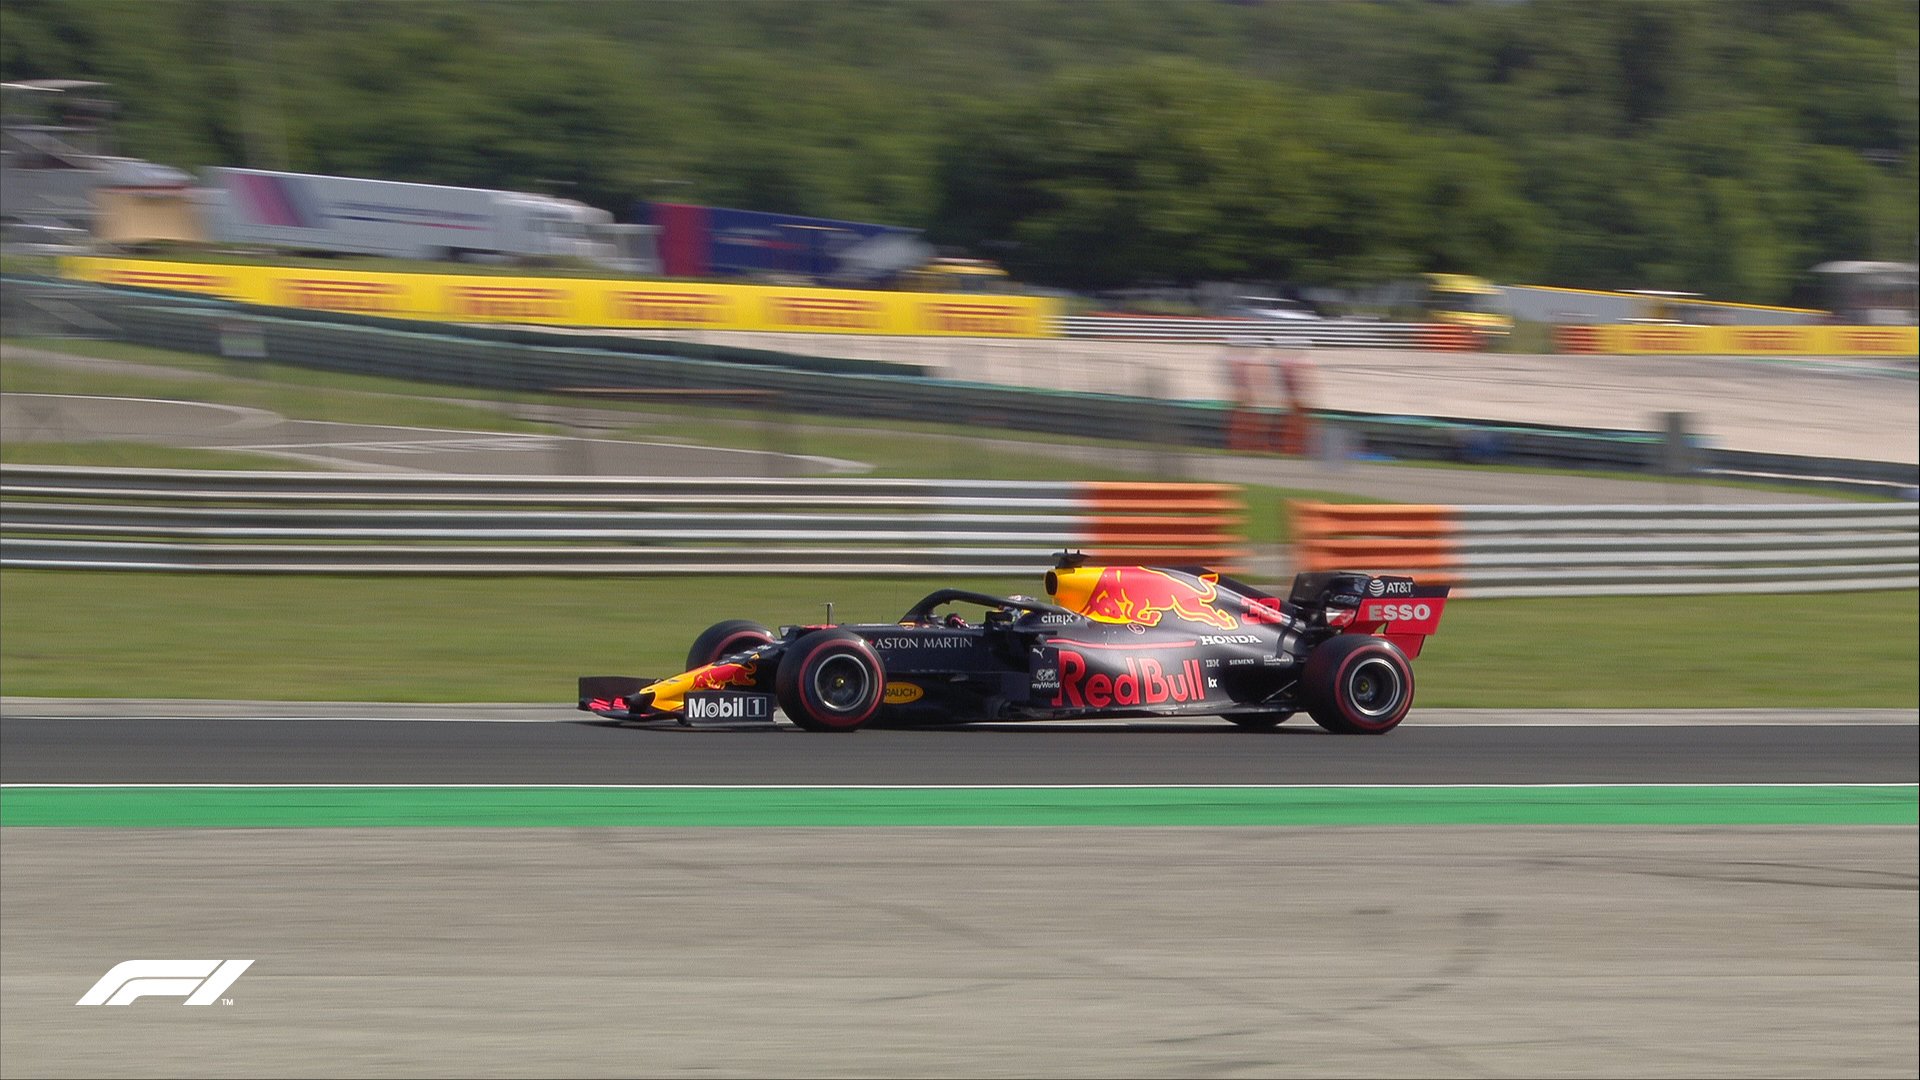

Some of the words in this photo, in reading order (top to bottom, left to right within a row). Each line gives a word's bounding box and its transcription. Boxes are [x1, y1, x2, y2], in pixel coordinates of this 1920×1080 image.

[1386, 582, 1413, 593] AT&T
[1369, 604, 1430, 620] ESSO
[875, 638, 918, 649] ASTON
[923, 637, 973, 648] MARTIN
[1200, 634, 1263, 645] HONDA
[1032, 682, 1060, 690] myWorld
[688, 697, 743, 718] Mobil
